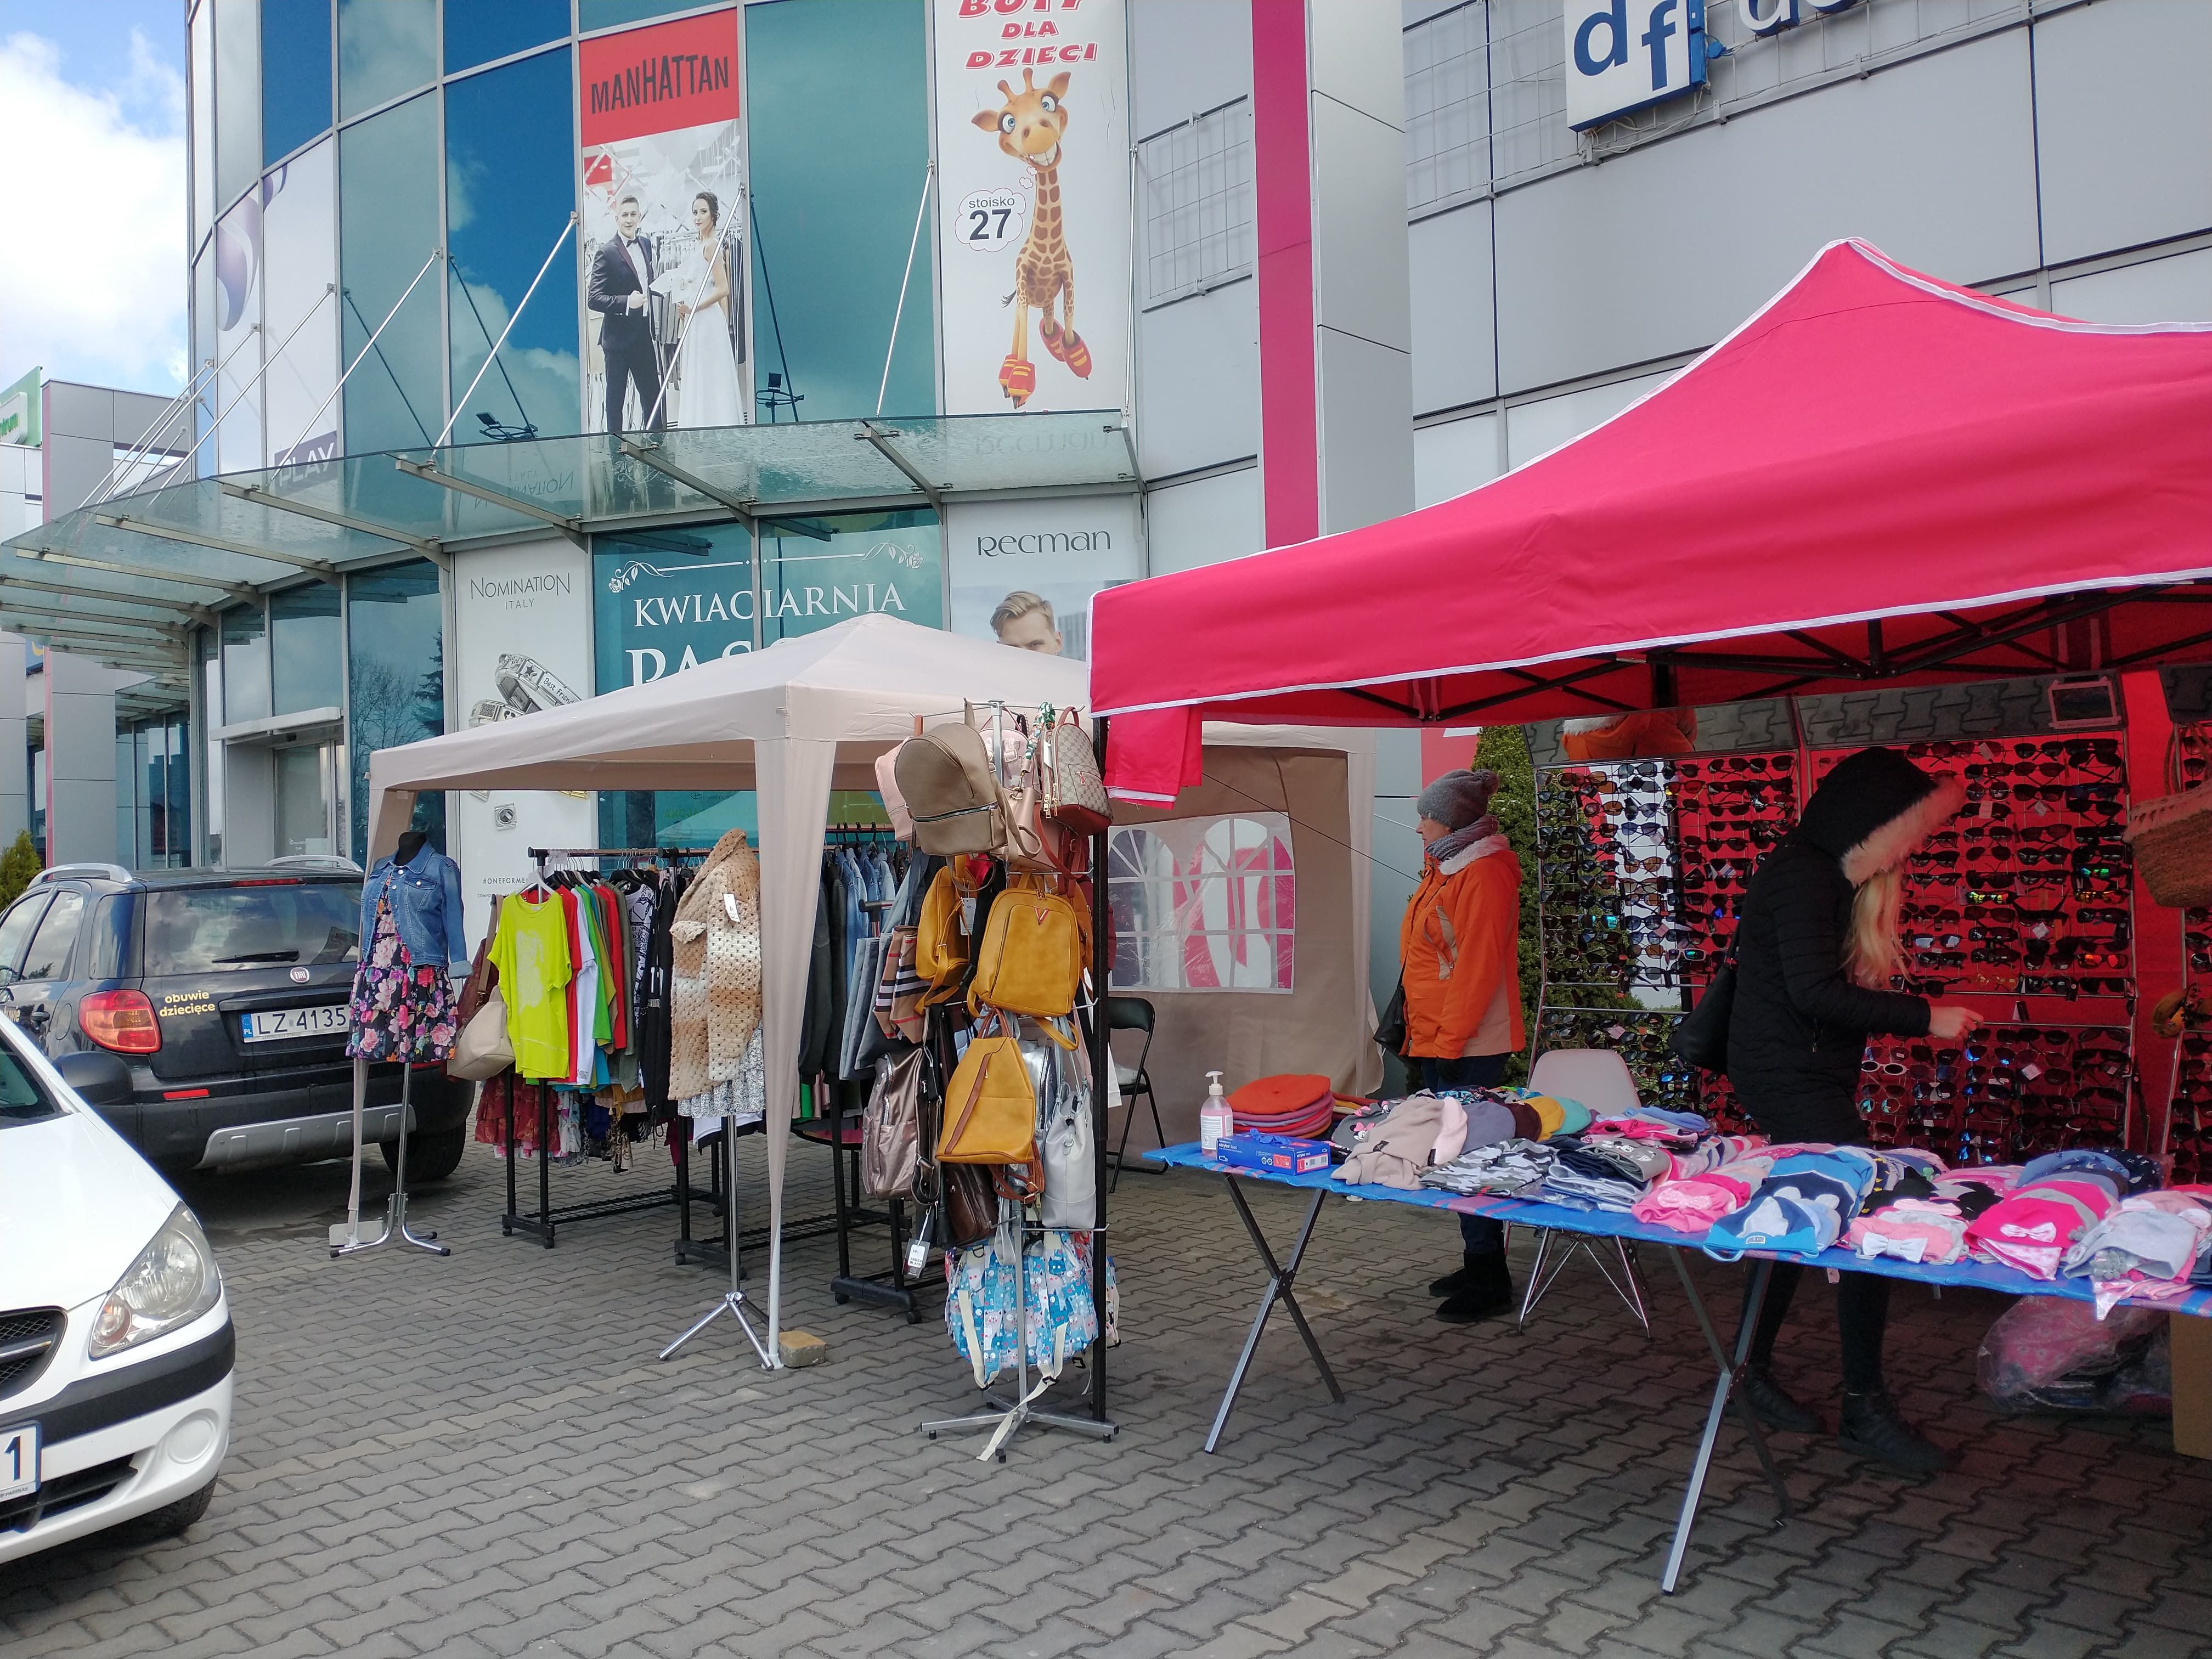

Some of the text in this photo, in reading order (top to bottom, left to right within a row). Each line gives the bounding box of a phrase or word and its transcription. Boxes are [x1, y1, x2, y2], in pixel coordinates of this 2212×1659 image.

[1001, 20, 1059, 40] DLA
[966, 42, 1098, 69] DZIECI
[591, 54, 729, 115] MANHATTAN
[969, 196, 1015, 208] stoisko
[969, 208, 1012, 240] 27
[279, 442, 335, 487] PLAY
[505, 598, 534, 610] ITALY
[634, 582, 907, 627] KWIACIARNIA
[543, 677, 556, 691] Best
[159, 1003, 216, 1017] dziecięce
[165, 990, 210, 1003] obuwie
[257, 1007, 346, 1035] LZ 4135
[4, 1435, 21, 1482] 1
